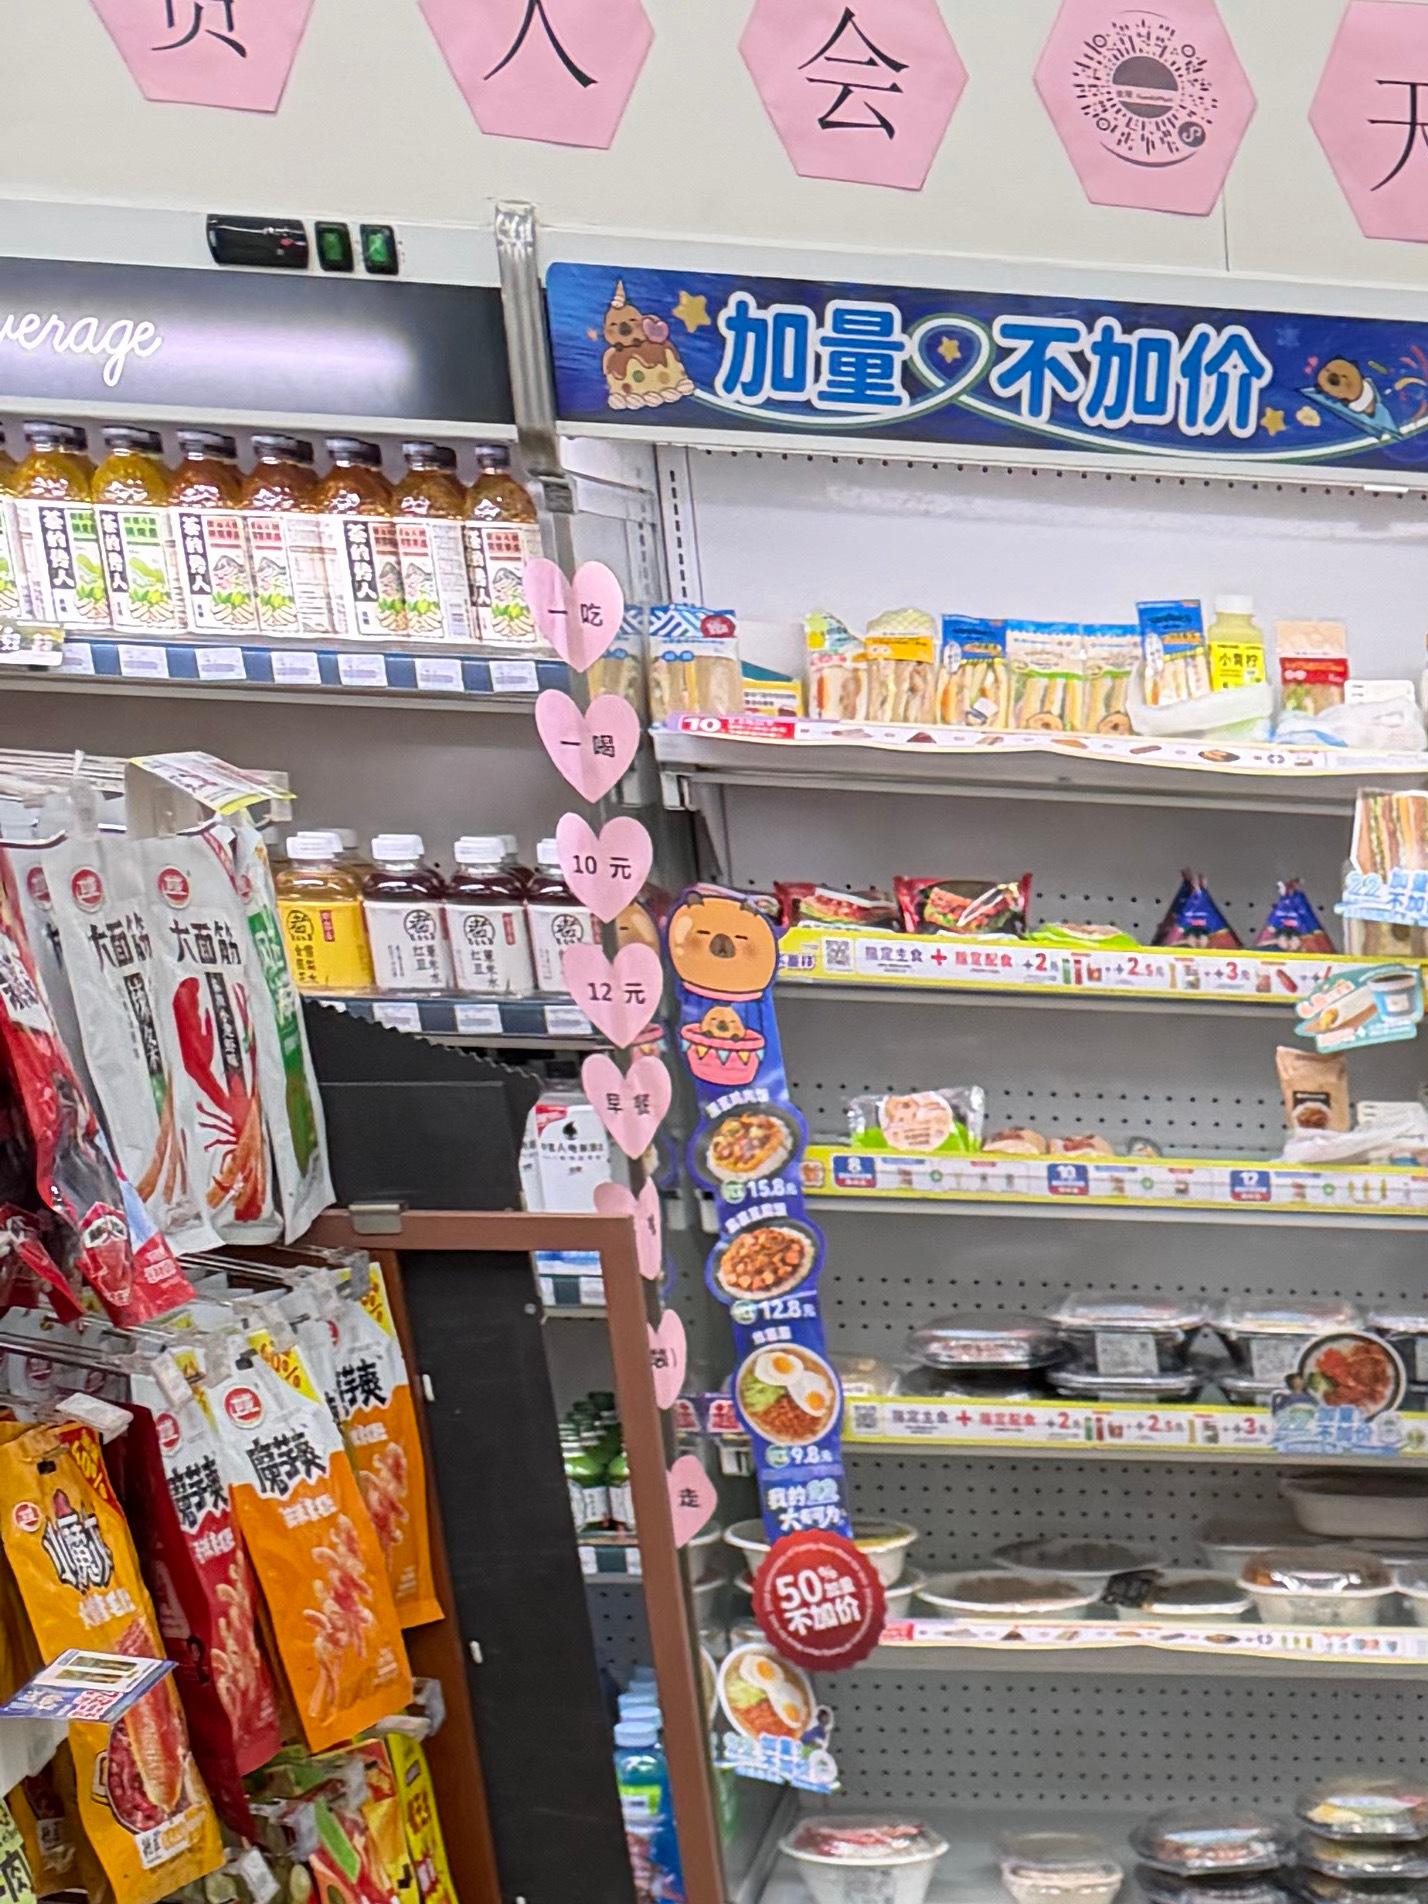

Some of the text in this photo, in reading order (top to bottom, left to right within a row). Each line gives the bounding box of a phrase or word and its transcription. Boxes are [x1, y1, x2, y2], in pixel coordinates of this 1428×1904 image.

[798, 6, 910, 140] 会
[717, 290, 1275, 437] 加量 不加价
[170, 917, 242, 966] 大面筋
